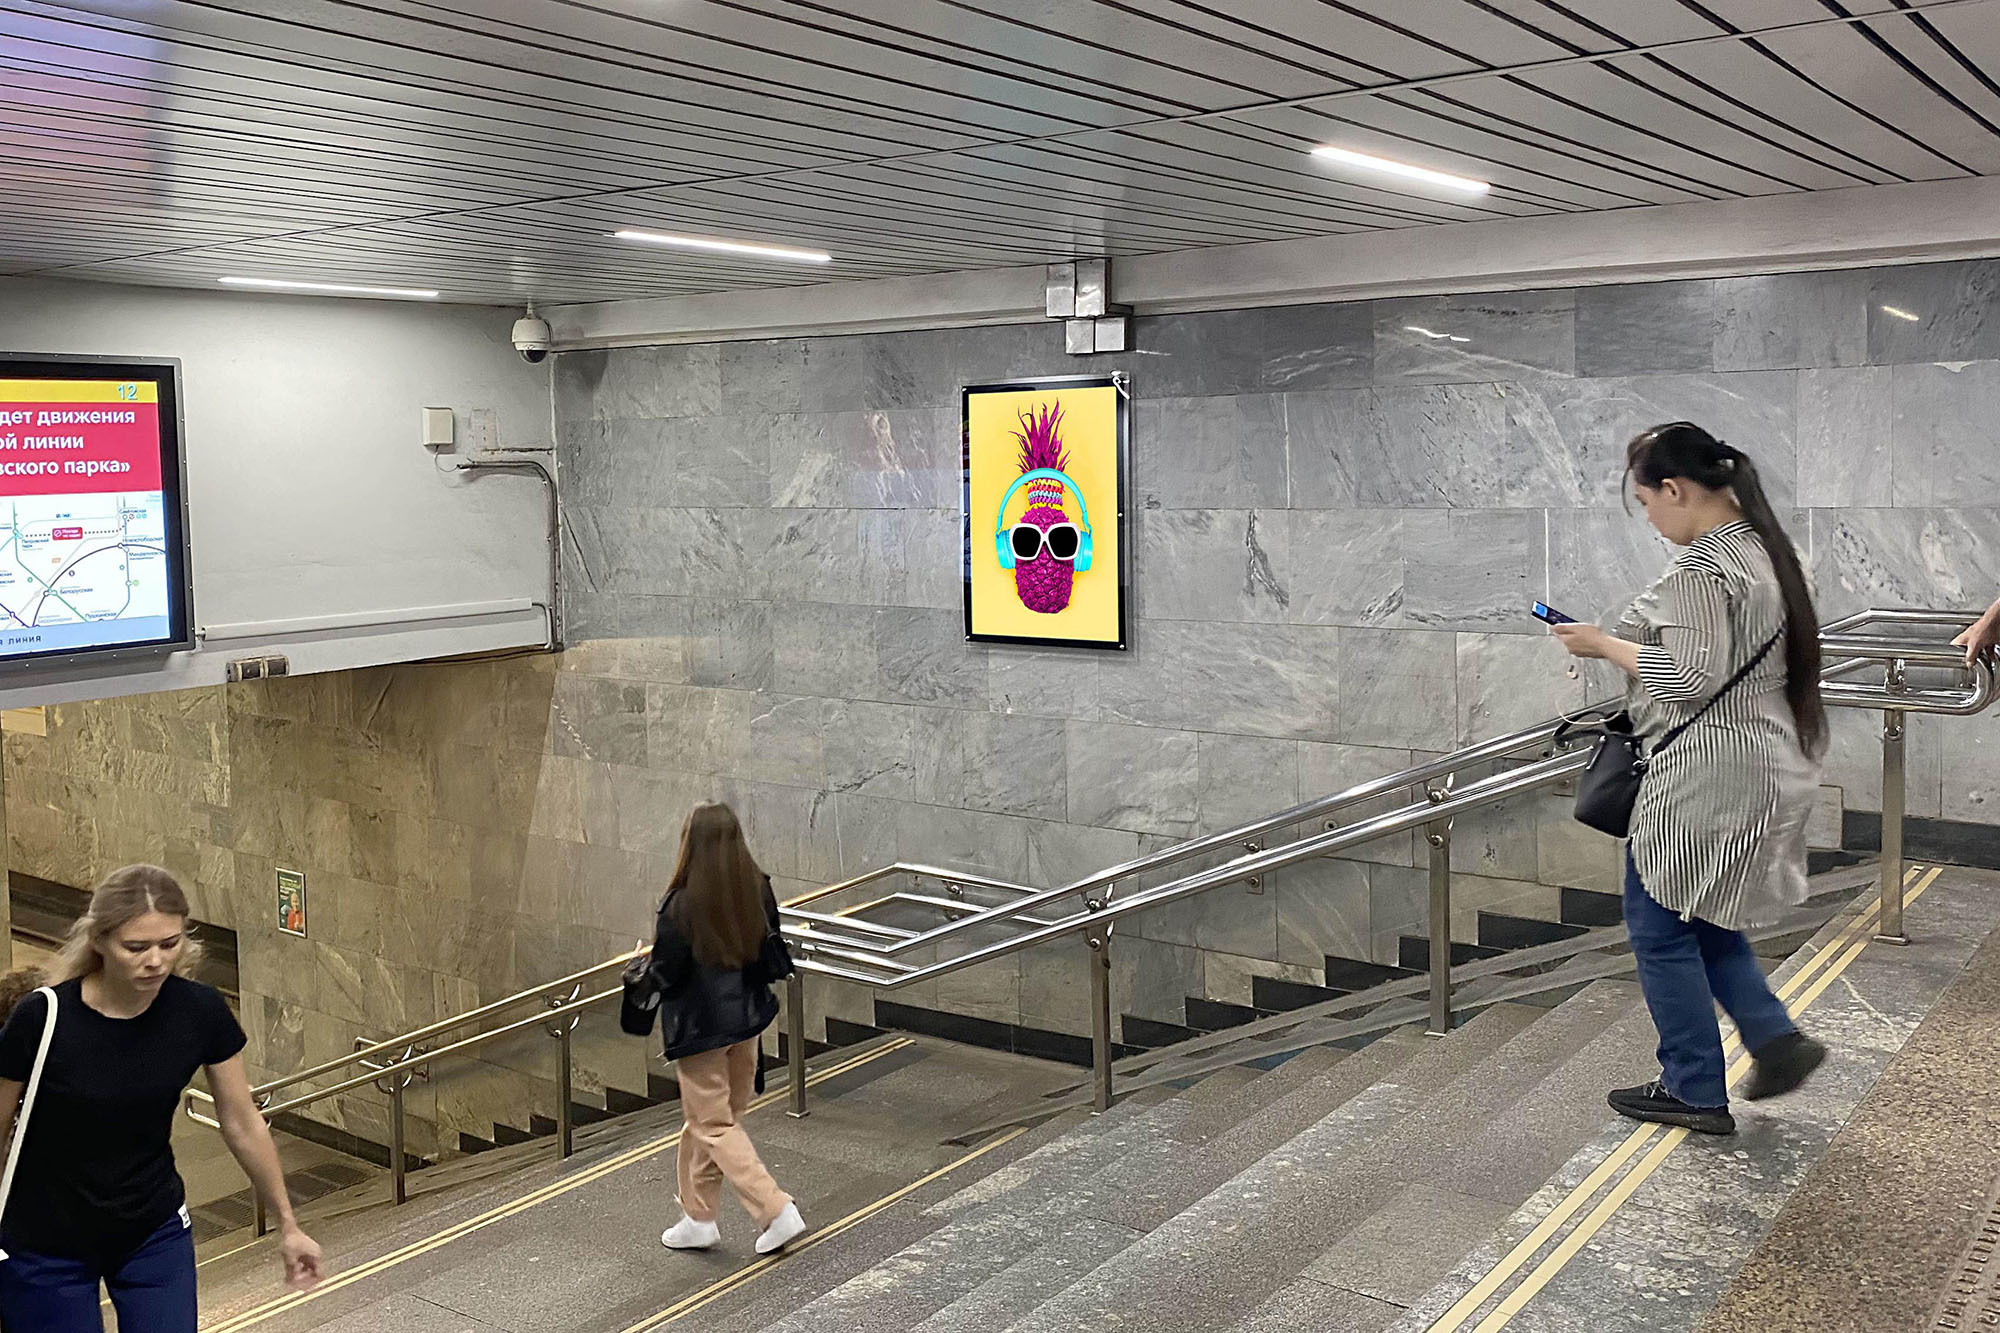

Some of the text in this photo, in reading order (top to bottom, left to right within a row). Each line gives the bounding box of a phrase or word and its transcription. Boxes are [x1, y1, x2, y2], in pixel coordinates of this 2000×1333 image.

[117, 384, 138, 400] 12
[37, 411, 135, 426] движения
[22, 436, 84, 449] линии
[63, 460, 130, 477] парка»
[8, 635, 41, 646] линия
